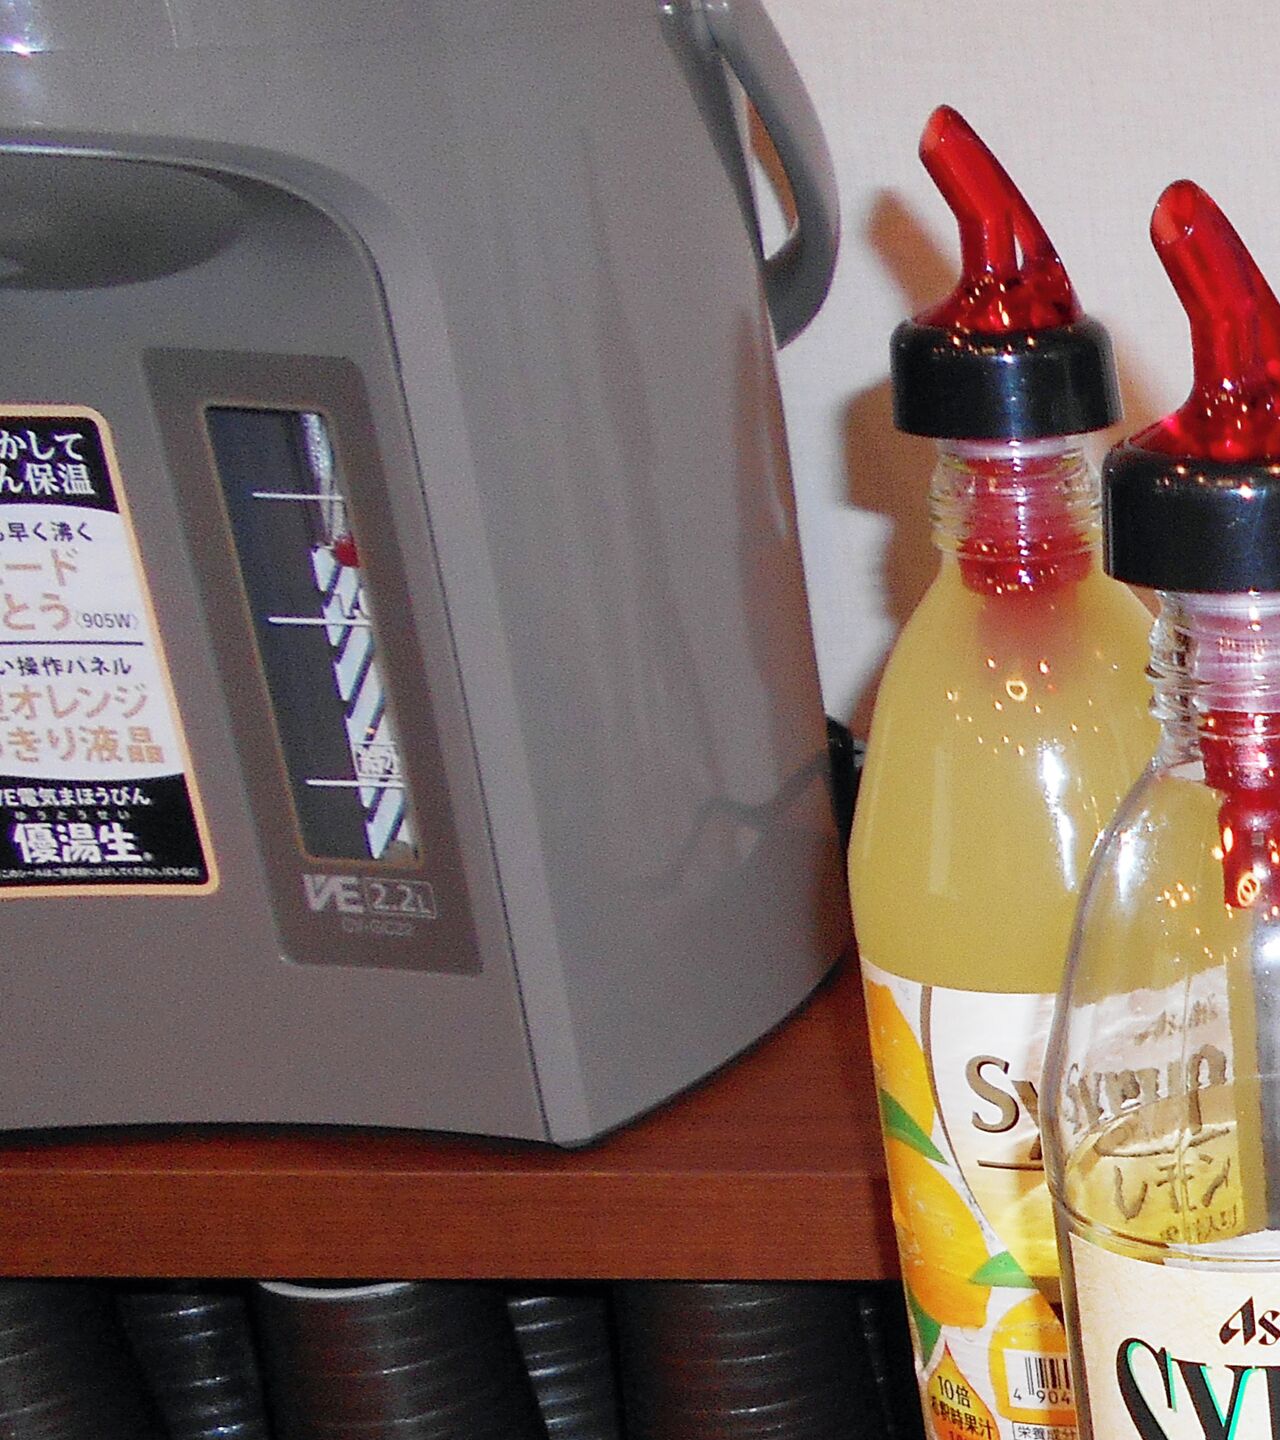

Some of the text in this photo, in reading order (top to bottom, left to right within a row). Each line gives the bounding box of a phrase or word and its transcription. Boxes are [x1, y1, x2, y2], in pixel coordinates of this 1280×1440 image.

[0, 521, 93, 542] 早く沸く
[0, 549, 78, 587] ード
[0, 683, 148, 721] オレンジ
[0, 726, 165, 764] きり液晶
